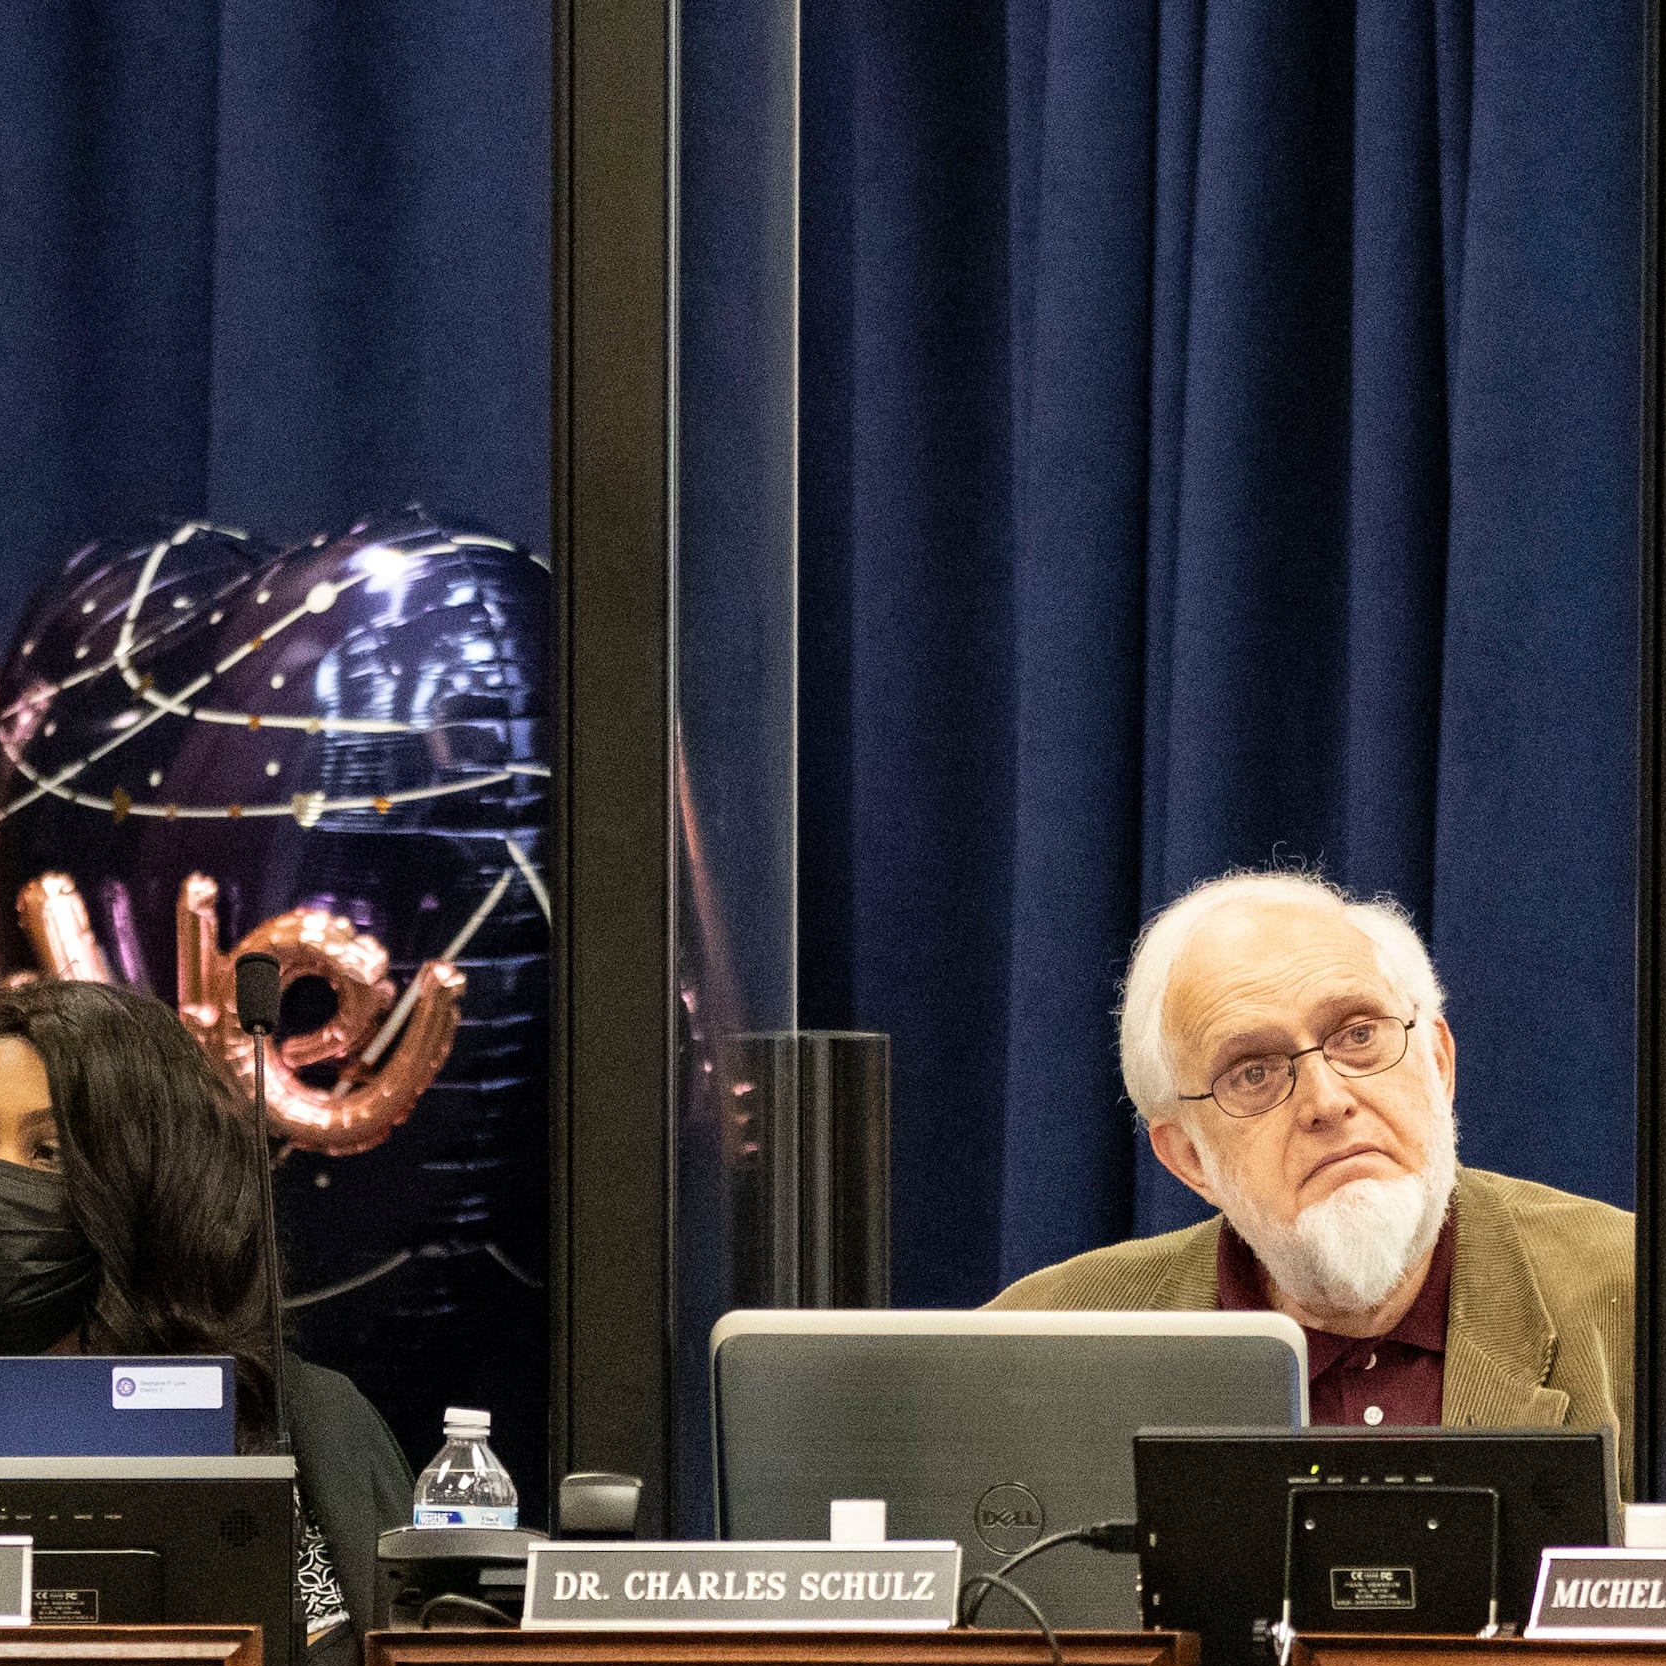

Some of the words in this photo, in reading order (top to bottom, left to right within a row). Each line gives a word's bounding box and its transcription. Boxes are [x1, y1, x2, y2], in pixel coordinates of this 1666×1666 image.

[553, 1571, 610, 1601] DR.
[623, 1570, 788, 1601] CHARLES
[798, 1569, 937, 1602] SCHULZ
